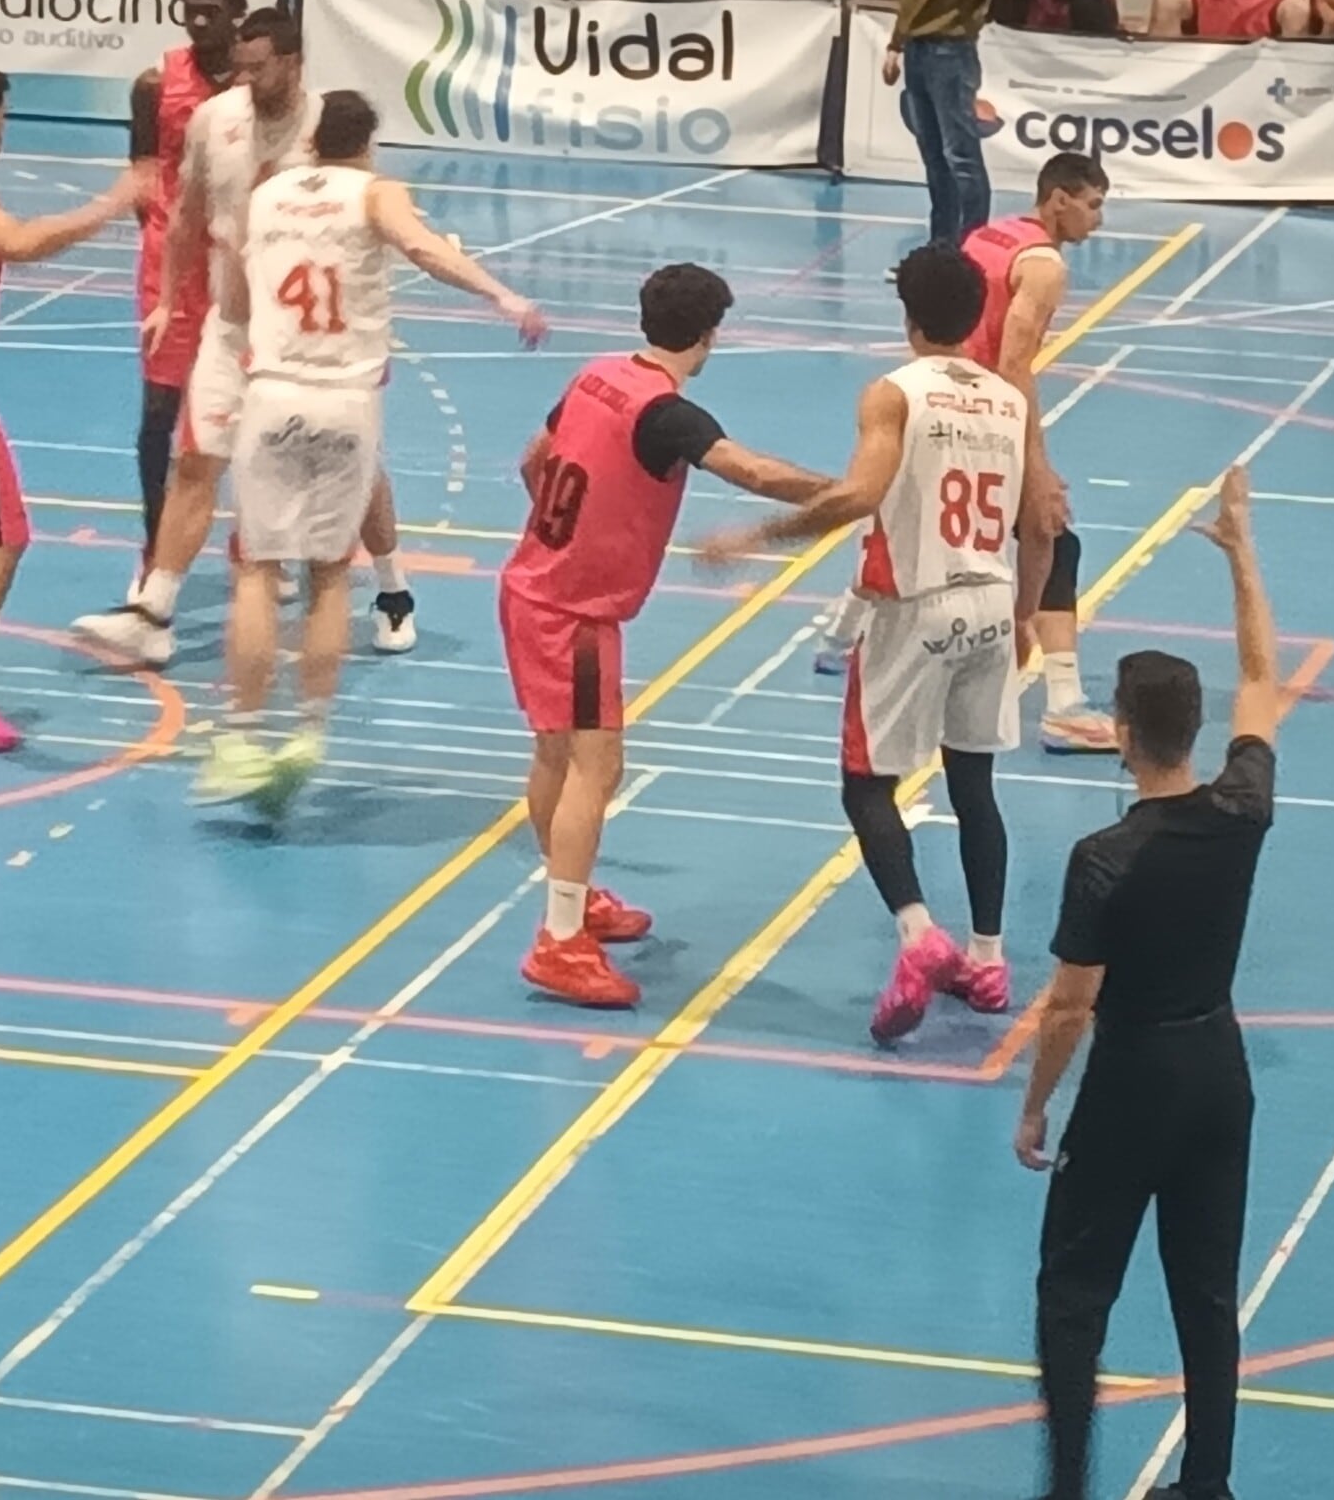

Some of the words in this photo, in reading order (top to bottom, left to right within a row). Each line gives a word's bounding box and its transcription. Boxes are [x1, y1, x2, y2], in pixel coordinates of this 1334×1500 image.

[23, 27, 124, 50] auditivo
[534, 6, 734, 82] Vidal
[527, 87, 731, 155] fisio
[1015, 104, 1286, 166] capselos
[277, 260, 347, 334] 41
[940, 469, 1005, 553] 85
